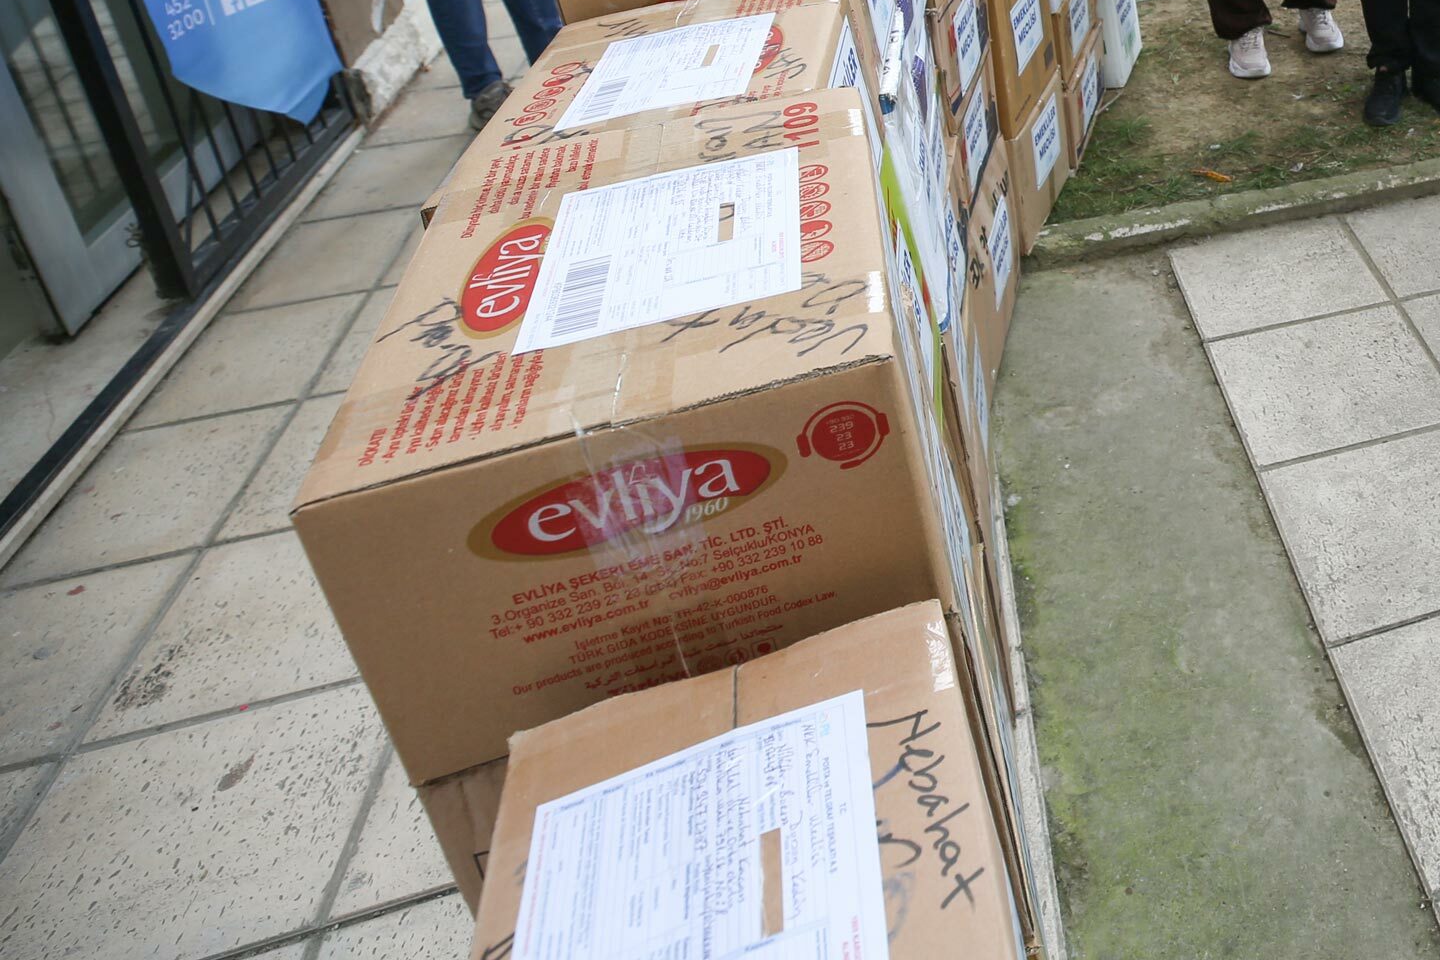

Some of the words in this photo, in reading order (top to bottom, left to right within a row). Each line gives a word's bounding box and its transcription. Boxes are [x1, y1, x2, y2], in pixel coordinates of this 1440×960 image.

[1017, 10, 1037, 46] MECLİSİ
[1034, 104, 1056, 148] EMEKLİLER
[1038, 128, 1056, 161] MECLİSİ
[487, 168, 499, 178] bir
[522, 210, 532, 220] bu
[530, 180, 542, 190] bir
[540, 148, 551, 166] sadece
[469, 233, 545, 319] evliya
[829, 421, 854, 433] 239
[836, 432, 852, 442] 23
[838, 441, 855, 451] 23
[527, 457, 741, 542] evliya
[684, 496, 729, 525] 1960
[512, 581, 567, 606] EVLİYA
[729, 526, 760, 543] LTD.
[762, 515, 788, 535] ŞTİ.
[713, 523, 815, 562] Selçuklu/KONYA
[526, 615, 544, 630] 90
[548, 607, 573, 624] 332
[576, 600, 601, 616] 239
[624, 588, 641, 601] 23
[711, 560, 735, 574] +90
[738, 552, 761, 568] 332
[764, 546, 787, 562] 239
[790, 540, 806, 553] 10
[808, 534, 824, 548] 88
[522, 598, 651, 644] www.evliya.com.tr
[621, 621, 650, 637] Kayıt
[512, 683, 533, 696] Our
[535, 668, 583, 689] products
[585, 661, 604, 672] are
[604, 647, 656, 668] produced
[706, 625, 717, 635] to
[718, 613, 756, 632] Turkish
[757, 604, 783, 619] Food
[784, 596, 813, 612] Codex
[568, 649, 605, 665] TÜRK
[607, 638, 638, 654] GIDA
[865, 707, 986, 910] Nebahat
